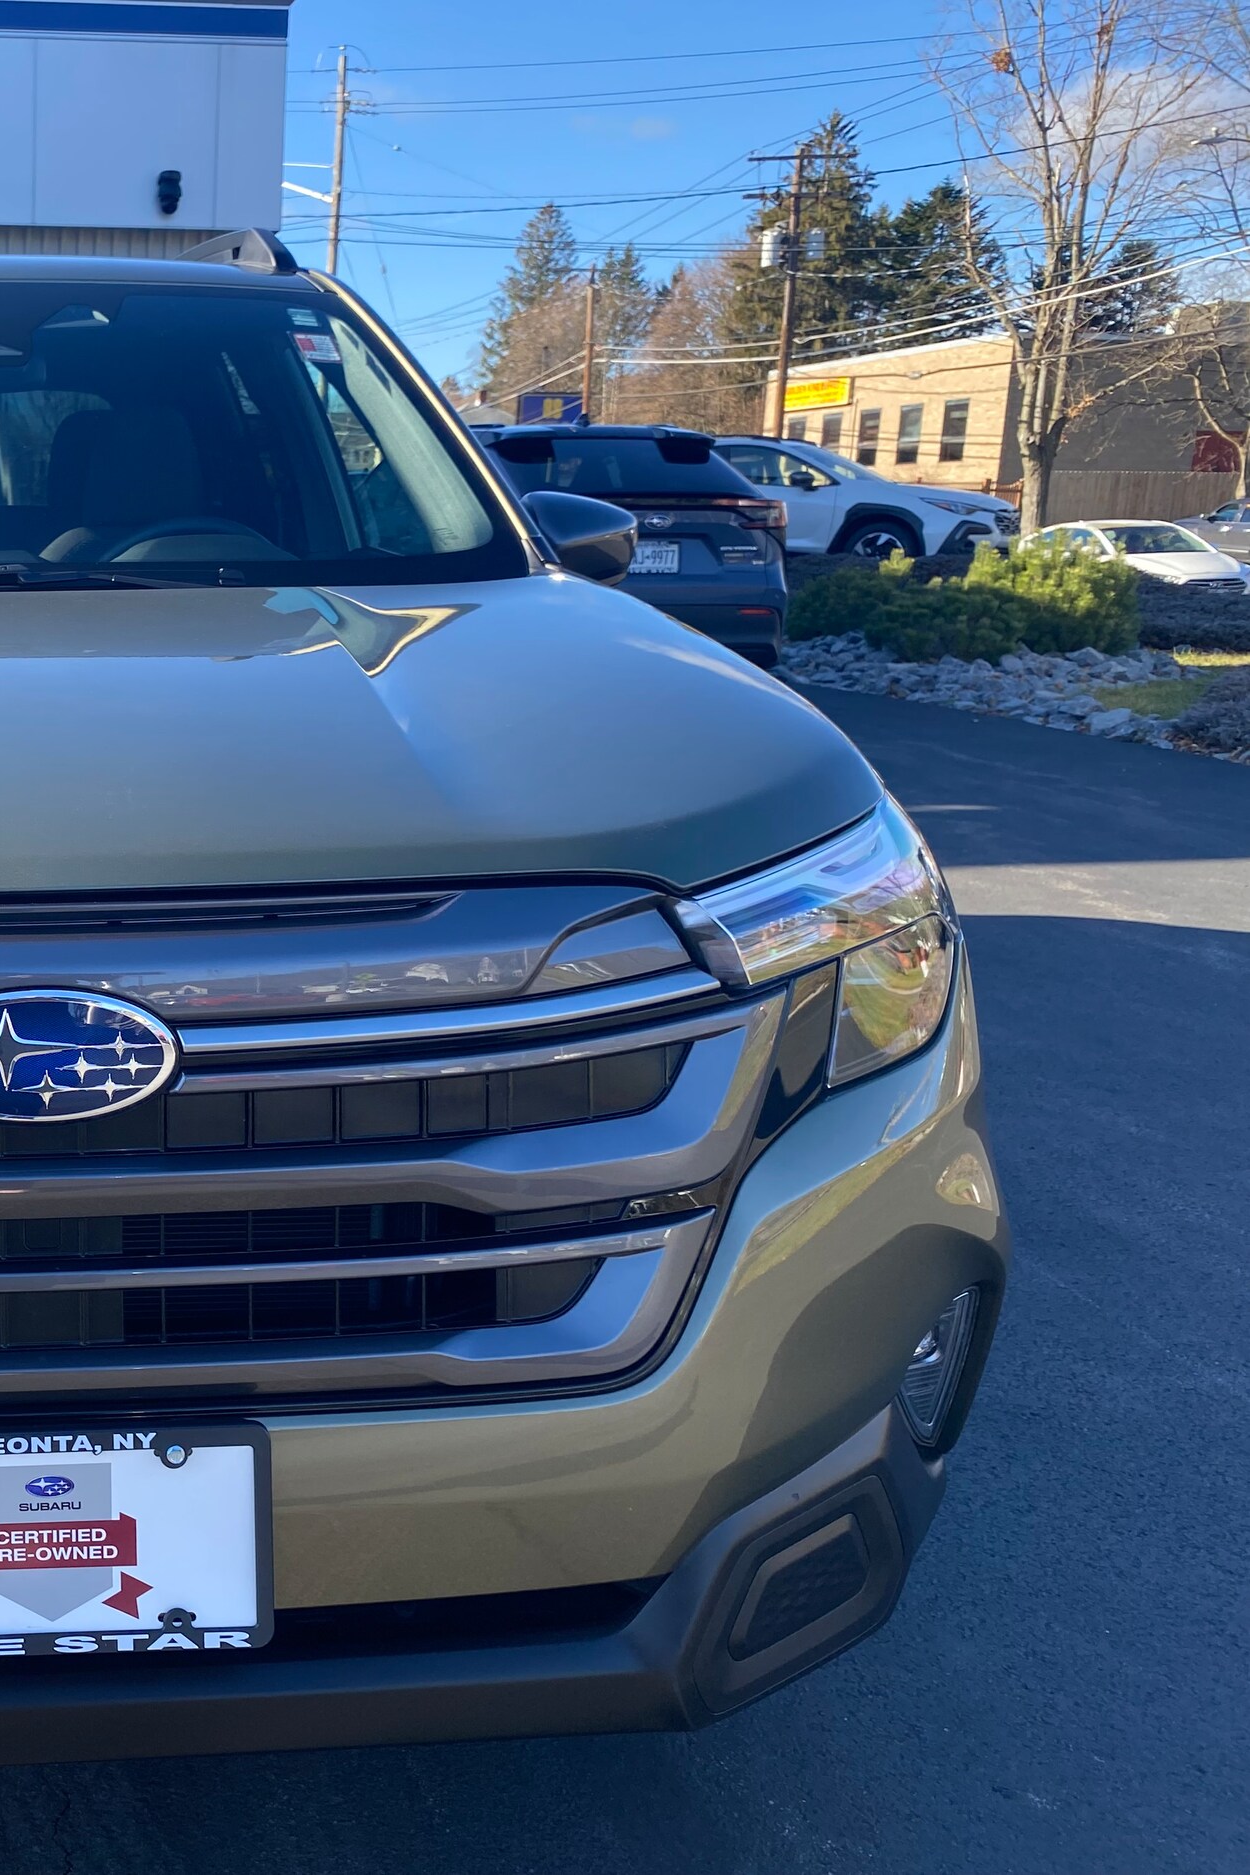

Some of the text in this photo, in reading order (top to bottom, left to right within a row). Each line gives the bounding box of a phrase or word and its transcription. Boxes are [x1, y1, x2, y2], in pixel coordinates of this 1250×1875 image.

[113, 1432, 157, 1450] NY
[18, 1501, 82, 1512] SUBARU
[52, 1630, 253, 1653] STAR
